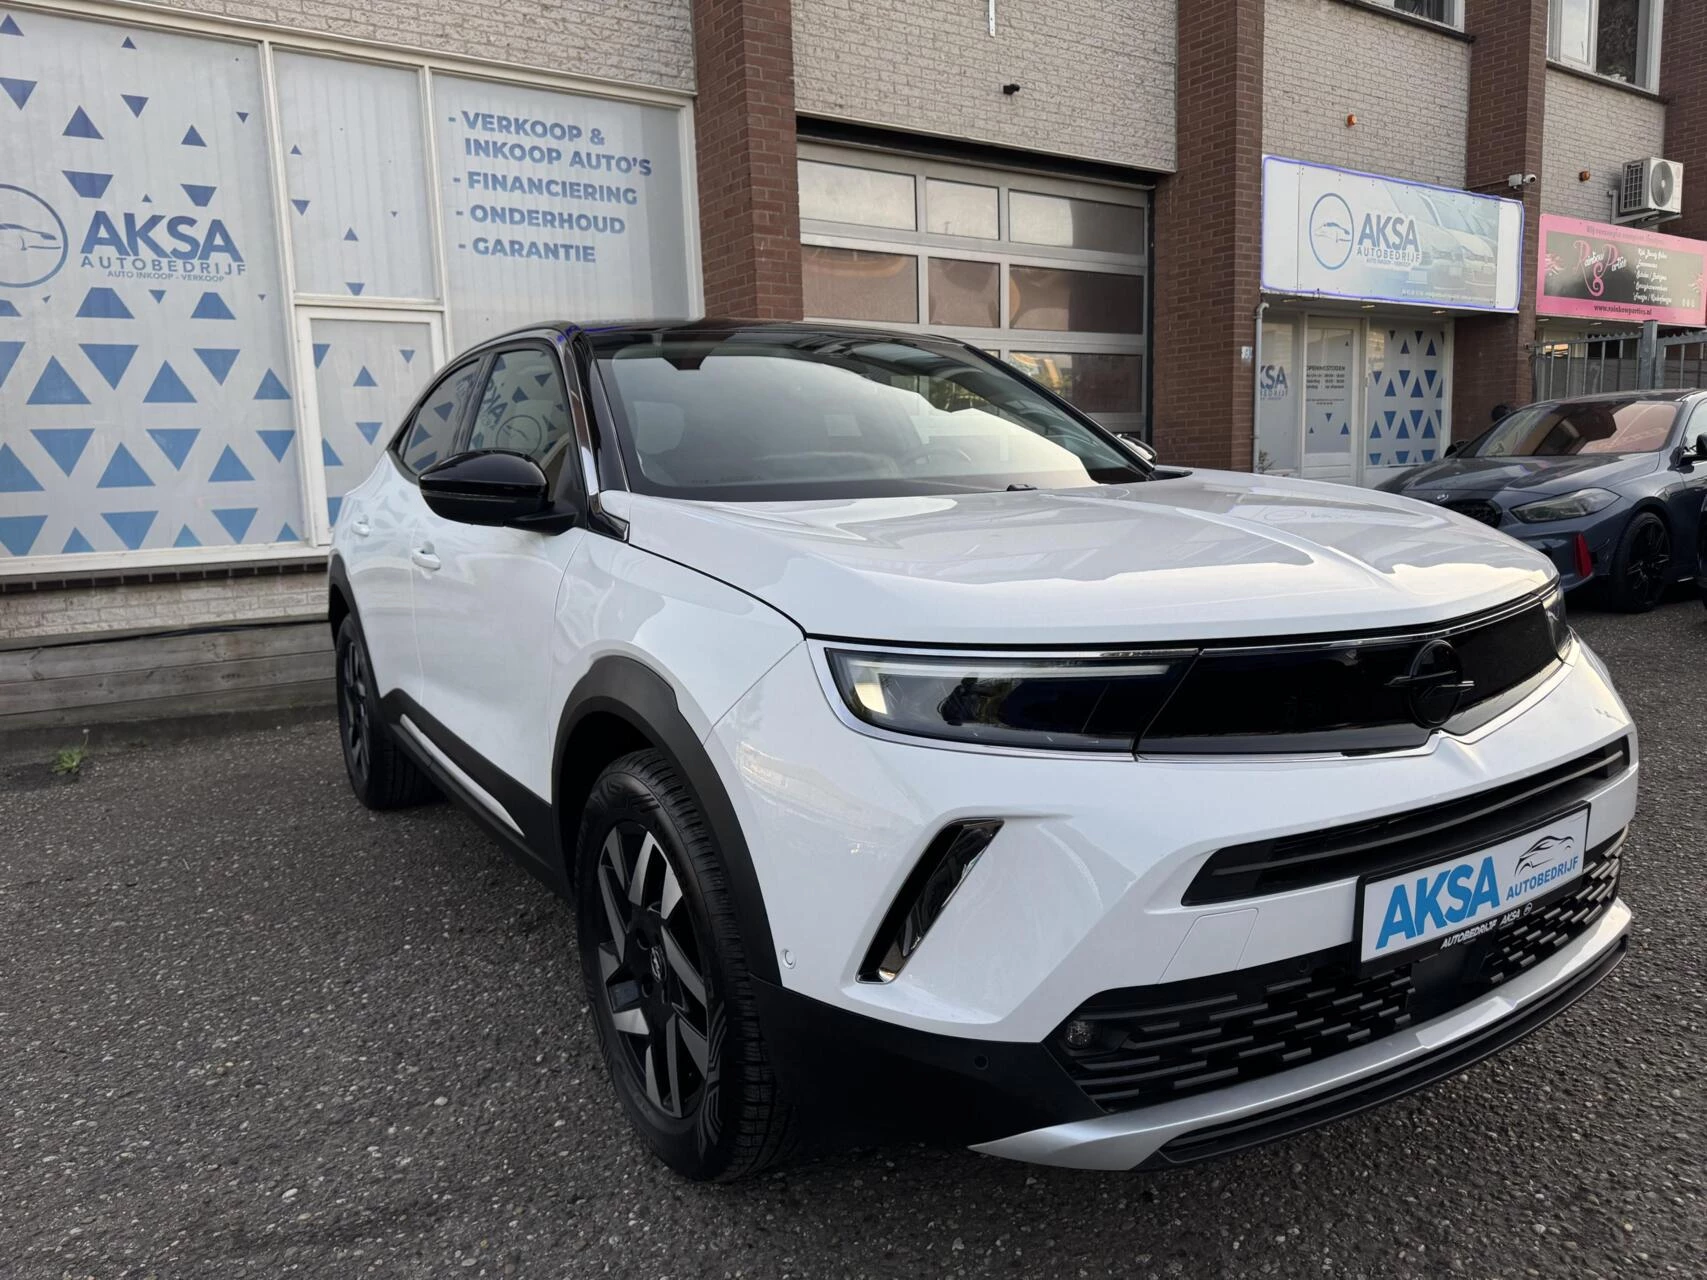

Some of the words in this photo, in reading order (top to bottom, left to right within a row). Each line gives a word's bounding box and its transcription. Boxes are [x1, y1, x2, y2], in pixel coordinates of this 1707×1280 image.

[461, 110, 582, 142] VERKOOP
[589, 128, 605, 146] &
[465, 138, 562, 165] INKOOP
[569, 150, 652, 177] AUTO'S
[467, 171, 637, 205] FINANCIERING
[80, 210, 244, 263] AKSA
[470, 204, 626, 235] ONDERHOUD
[1357, 212, 1420, 253] AKSA
[80, 255, 247, 276] AUTOBEDRIJF
[473, 237, 596, 263] GARANTIE
[1356, 246, 1421, 263] AUTOBEDRIJF
[107, 270, 134, 279] AUTO
[136, 271, 174, 281] INKOOP
[182, 274, 225, 283] VERKOOP
[1505, 856, 1579, 901] AUTOBEDRIJF
[1375, 856, 1501, 950] AKSA
[1440, 918, 1498, 950] AUTOBEDRIJF
[1499, 908, 1521, 926] AKSA
